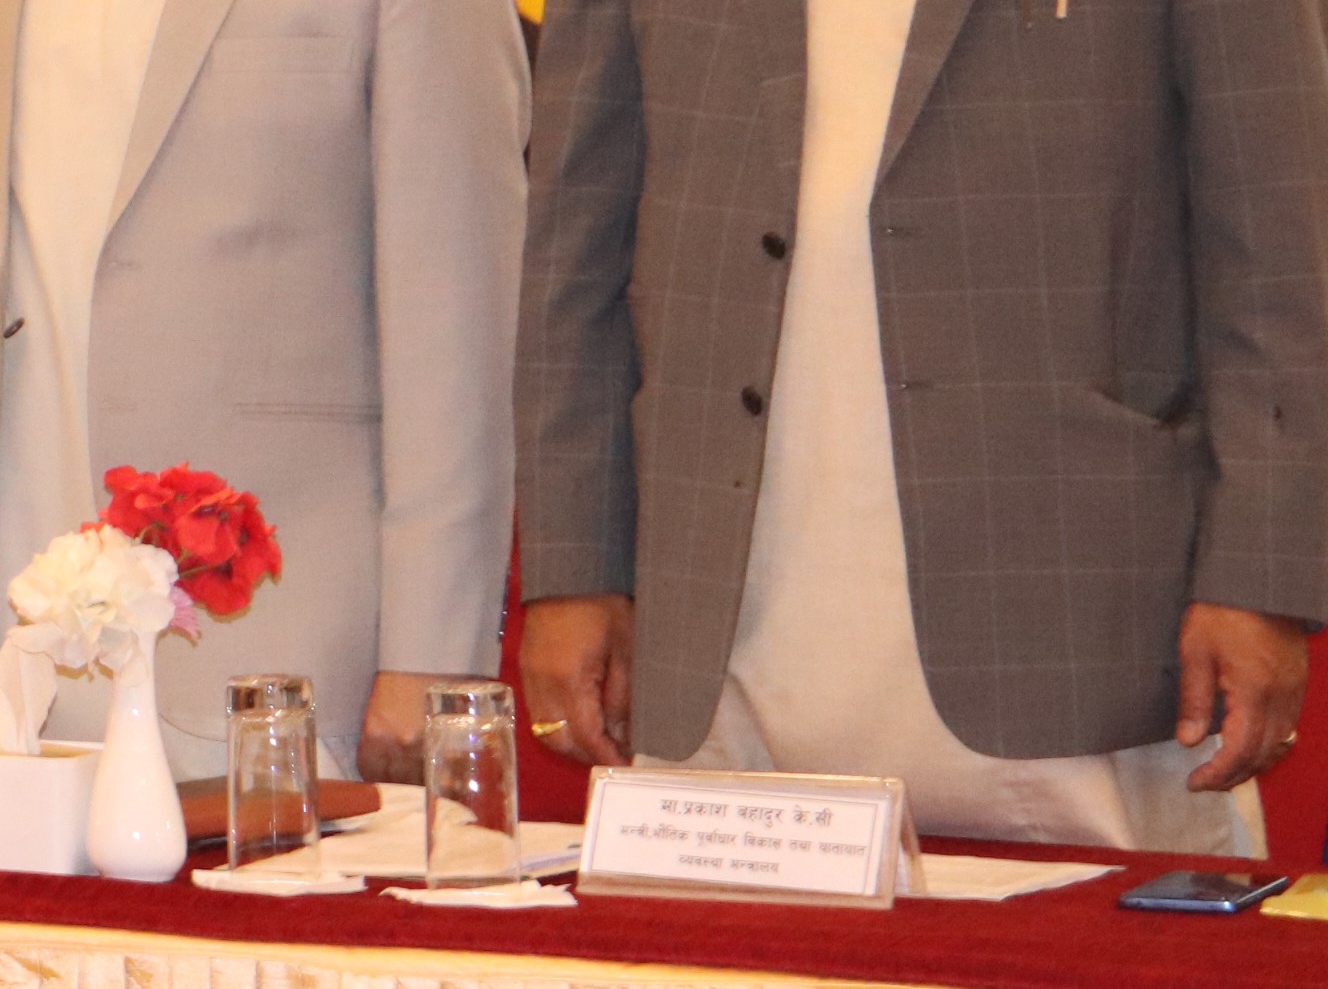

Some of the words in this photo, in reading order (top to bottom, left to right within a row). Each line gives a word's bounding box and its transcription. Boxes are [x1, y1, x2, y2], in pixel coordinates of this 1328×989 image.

[737, 805, 784, 828] बहादुर
[789, 840, 812, 853] तथा
[729, 859, 779, 875] मन्त्रालय
